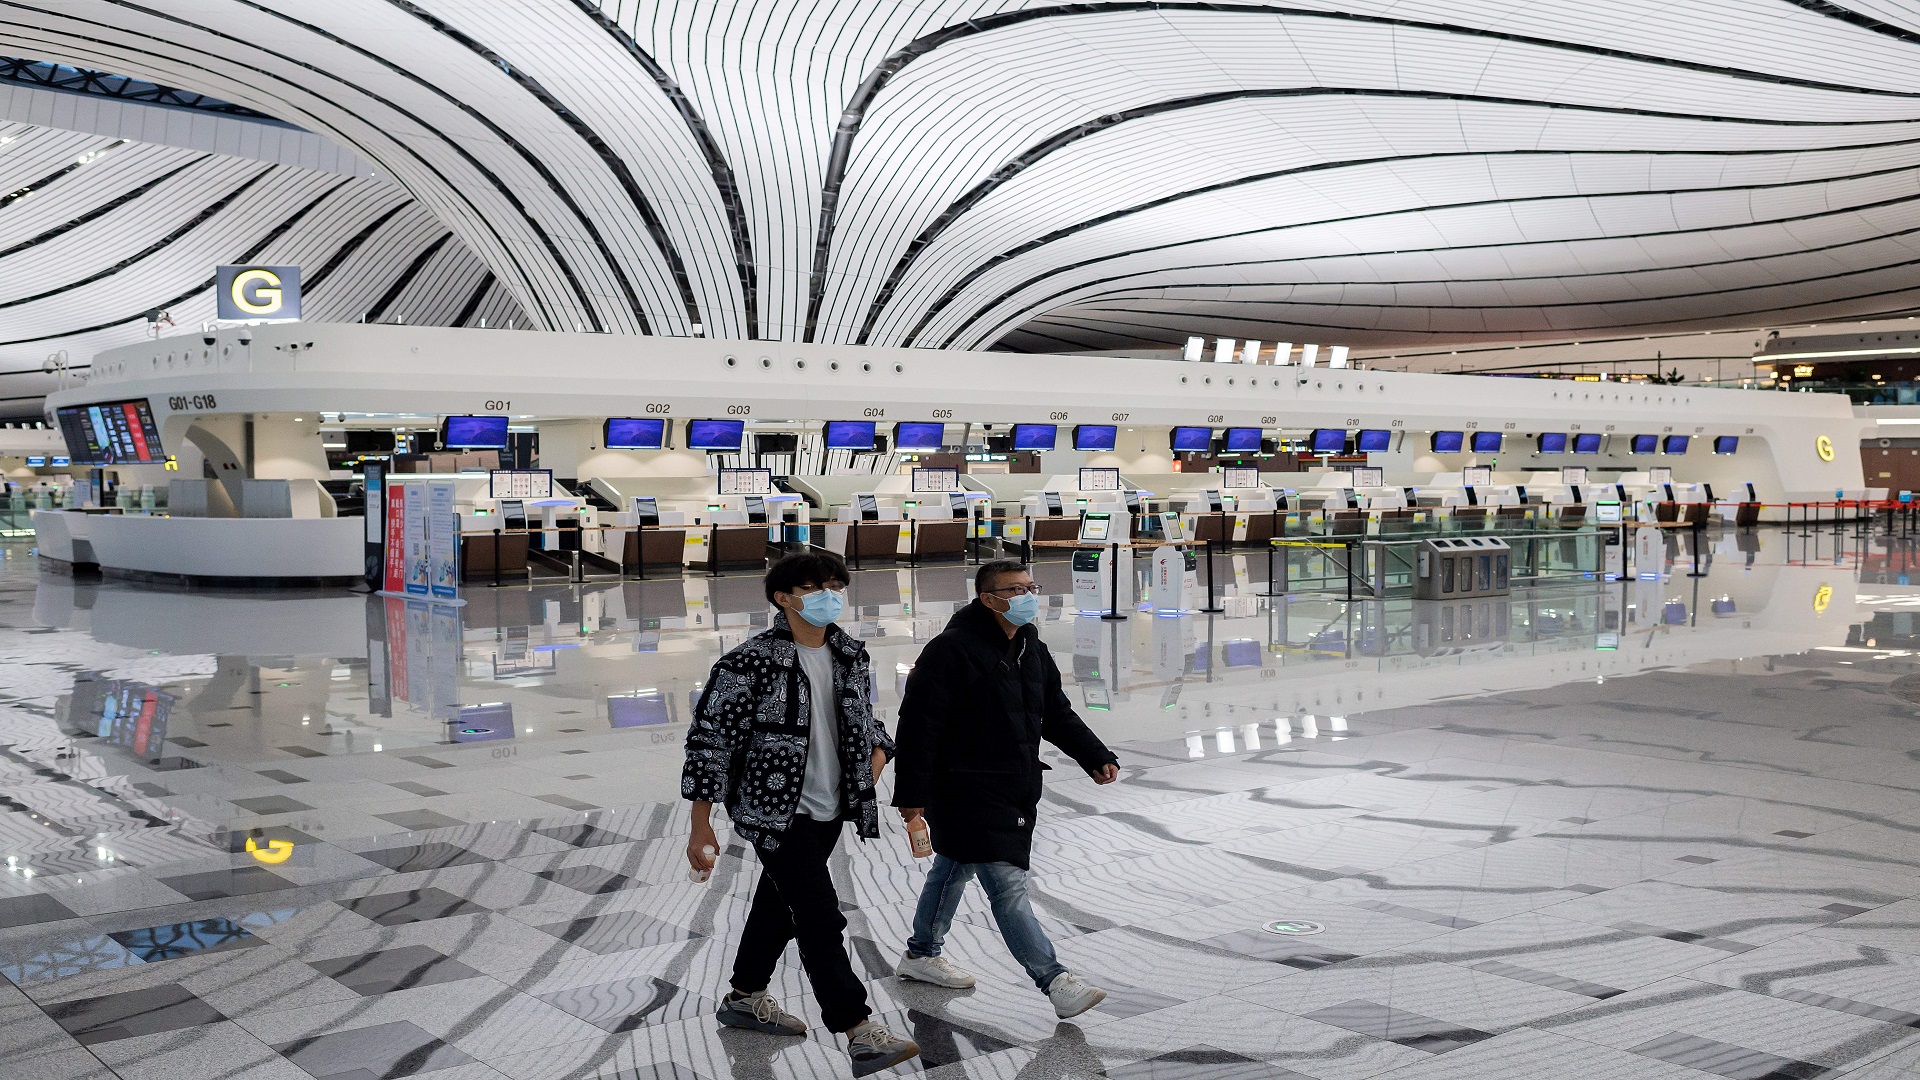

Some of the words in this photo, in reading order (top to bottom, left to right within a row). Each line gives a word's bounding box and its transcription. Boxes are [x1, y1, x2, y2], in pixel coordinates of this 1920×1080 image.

[231, 269, 283, 315] G
[168, 394, 217, 411] G01-G18
[484, 400, 511, 411] G01
[645, 403, 671, 414] G02
[727, 405, 751, 415] G03
[863, 407, 885, 417] G04
[932, 409, 953, 419] G05
[1049, 412, 1069, 421] G06
[1111, 413, 1130, 422] G07
[1207, 415, 1224, 423] G08
[1261, 416, 1277, 425] G09
[1346, 418, 1360, 426] G10
[1465, 421, 1478, 429] G12
[1816, 434, 1835, 463] G
